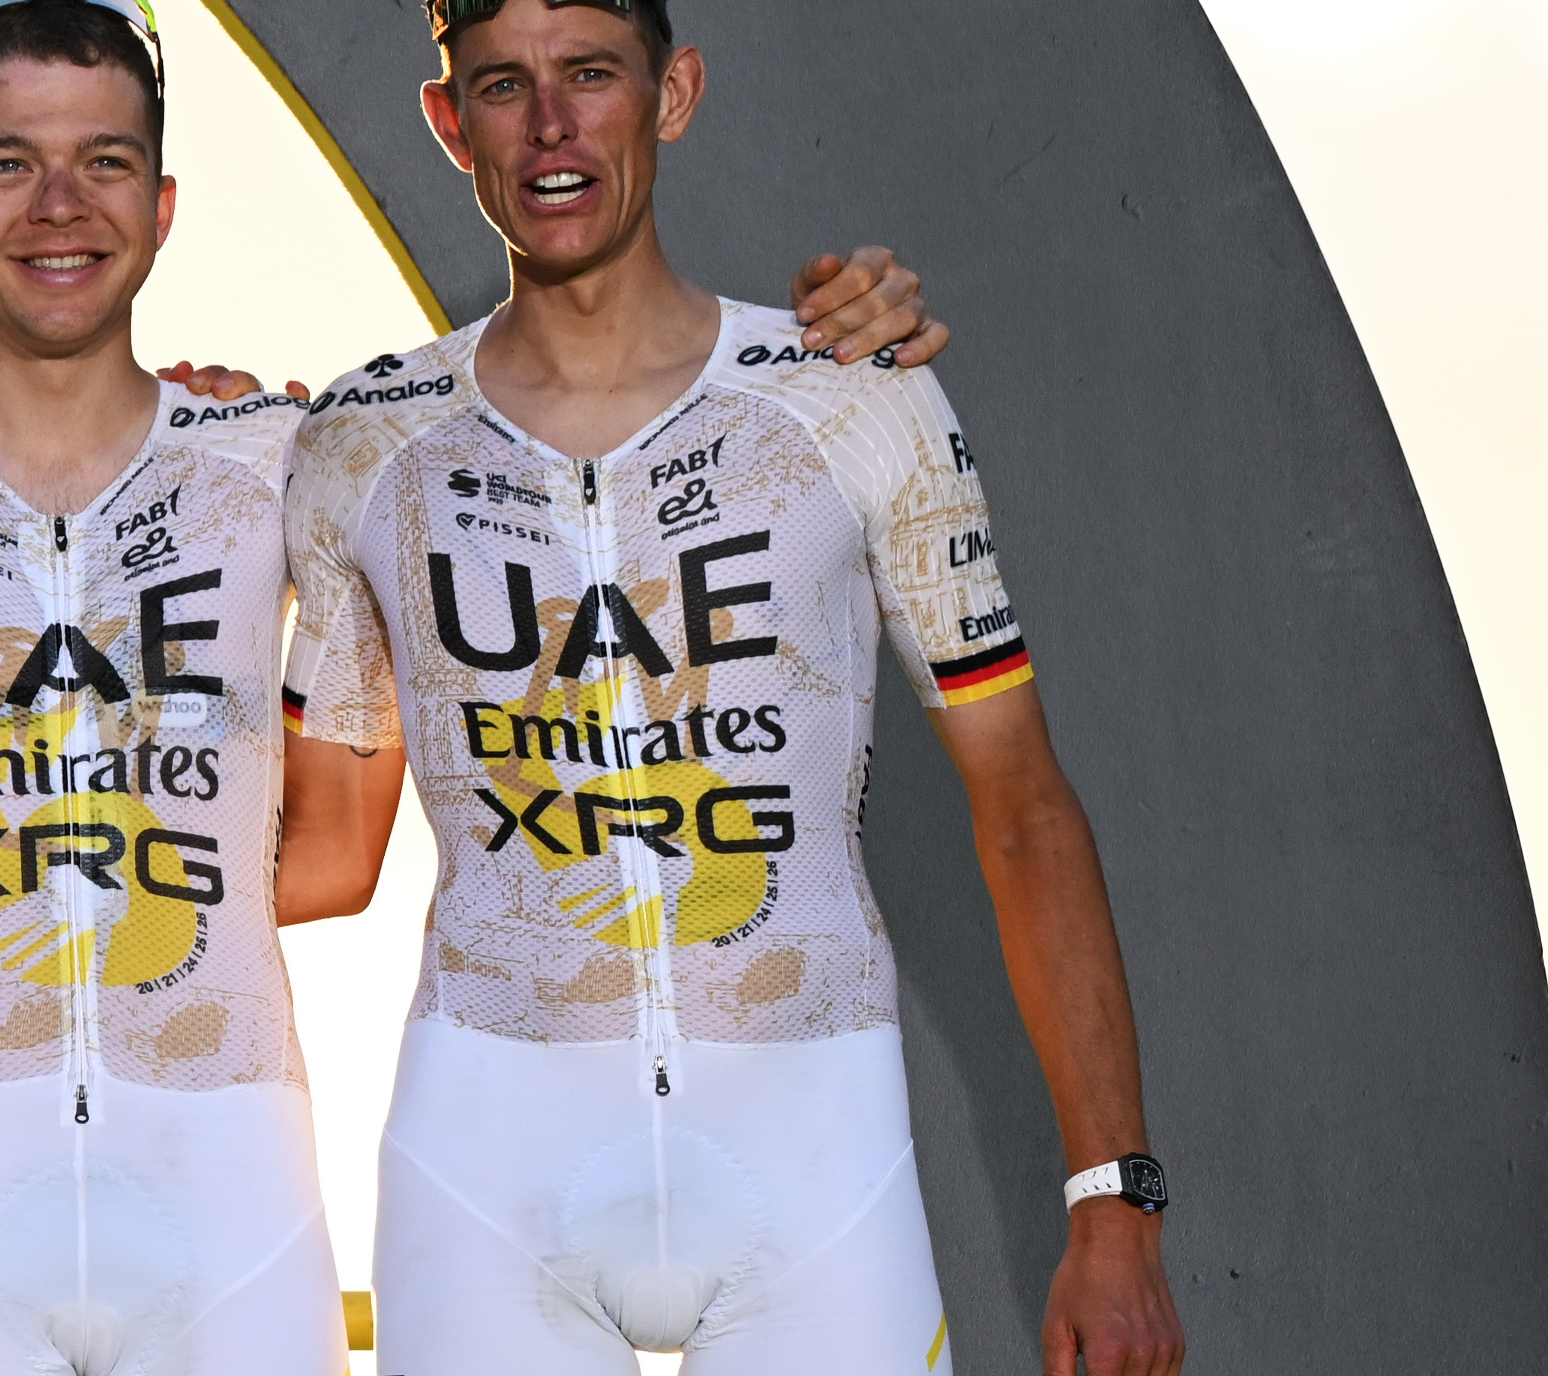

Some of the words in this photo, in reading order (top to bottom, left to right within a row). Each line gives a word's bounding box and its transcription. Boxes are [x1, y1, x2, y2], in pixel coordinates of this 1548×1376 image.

[337, 374, 454, 407] Analog
[486, 472, 506, 482] UCI
[486, 480, 552, 505] WORLDTOUR
[486, 488, 511, 500] BEST
[513, 494, 541, 508] TEAM
[702, 512, 720, 525] and
[479, 521, 550, 544] PISSEI
[428, 531, 777, 678] UAE
[459, 699, 787, 766] Emirates
[473, 784, 795, 858] XRG
[766, 861, 778, 876] 26
[766, 886, 778, 901] 25
[196, 912, 208, 929] 26
[756, 907, 772, 922] 24
[737, 924, 754, 938] 21
[195, 936, 207, 953] 25
[712, 936, 730, 948] 20
[183, 956, 198, 973] 24
[136, 981, 154, 995] 20
[161, 973, 178, 987] 21
